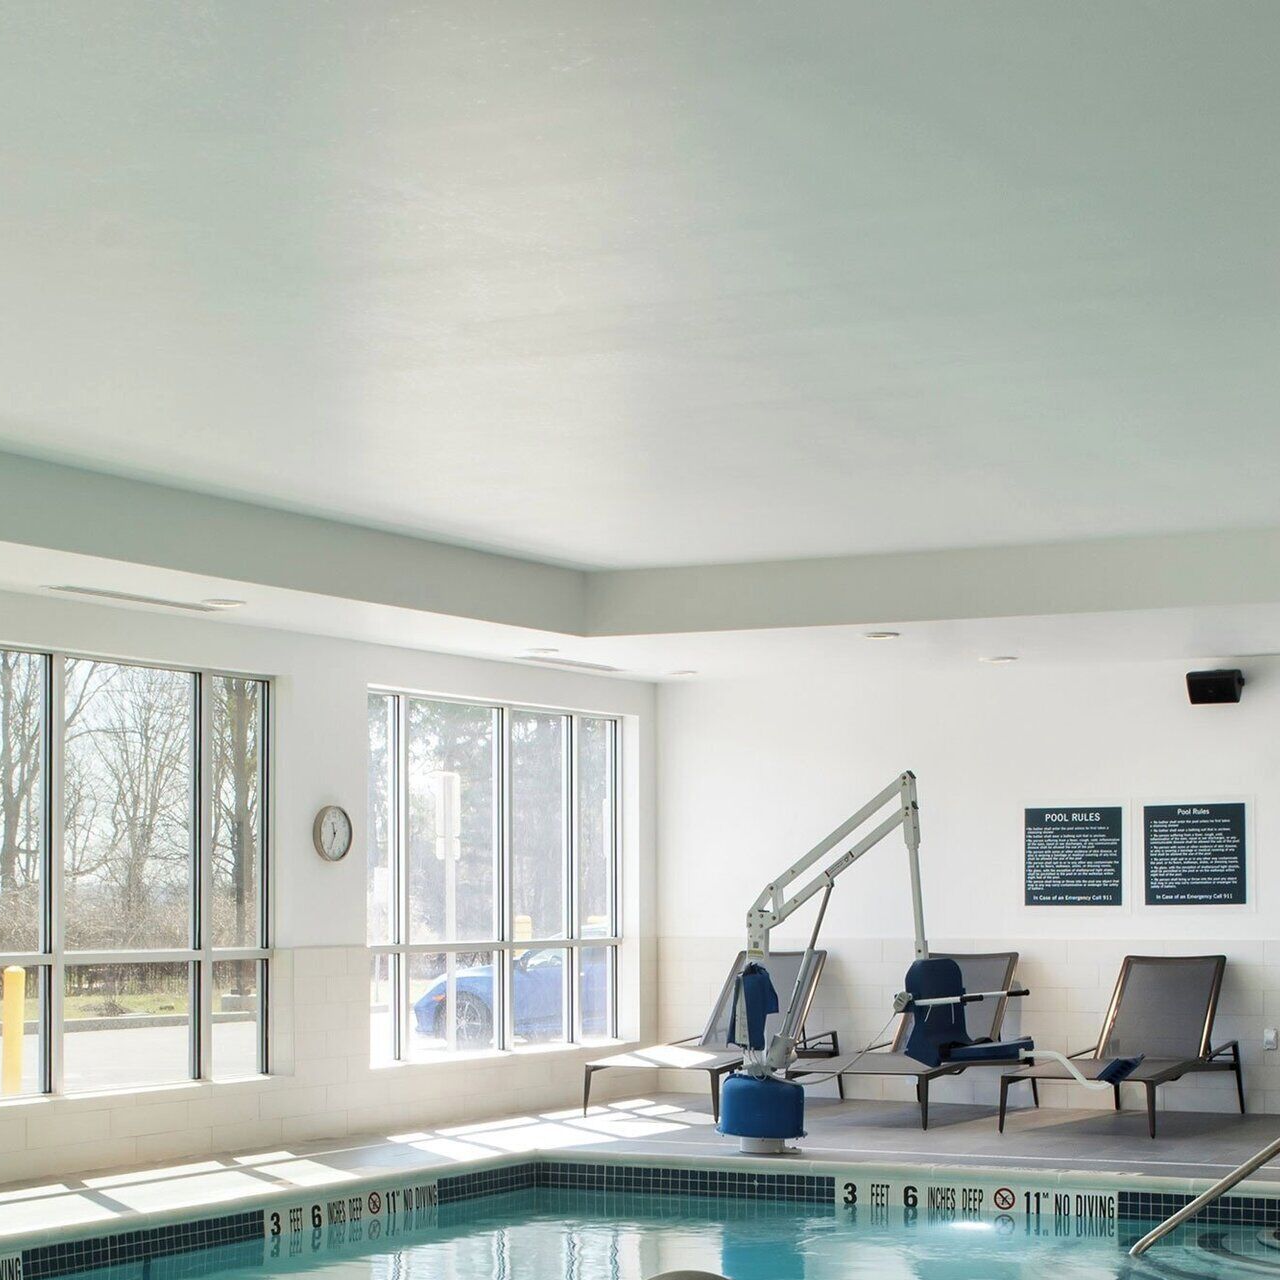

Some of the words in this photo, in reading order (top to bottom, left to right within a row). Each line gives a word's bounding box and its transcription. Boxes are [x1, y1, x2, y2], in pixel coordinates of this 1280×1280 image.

[1045, 813, 1069, 822] POOL
[1071, 812, 1101, 822] RULES
[270, 1212, 281, 1236] 3
[289, 1207, 303, 1232] FEET
[311, 1205, 322, 1228] 6
[327, 1200, 346, 1226] INCHES
[348, 1197, 363, 1222] DEEP
[403, 1188, 414, 1211] NO
[415, 1184, 437, 1210] DIVING
[843, 1182, 857, 1205] 3
[870, 1183, 890, 1208] FEET
[903, 1185, 918, 1208] 6
[927, 1186, 956, 1211] INCHES
[962, 1188, 984, 1211] DEEP
[1055, 1193, 1070, 1216] NO
[1076, 1194, 1115, 1219] DIVING
